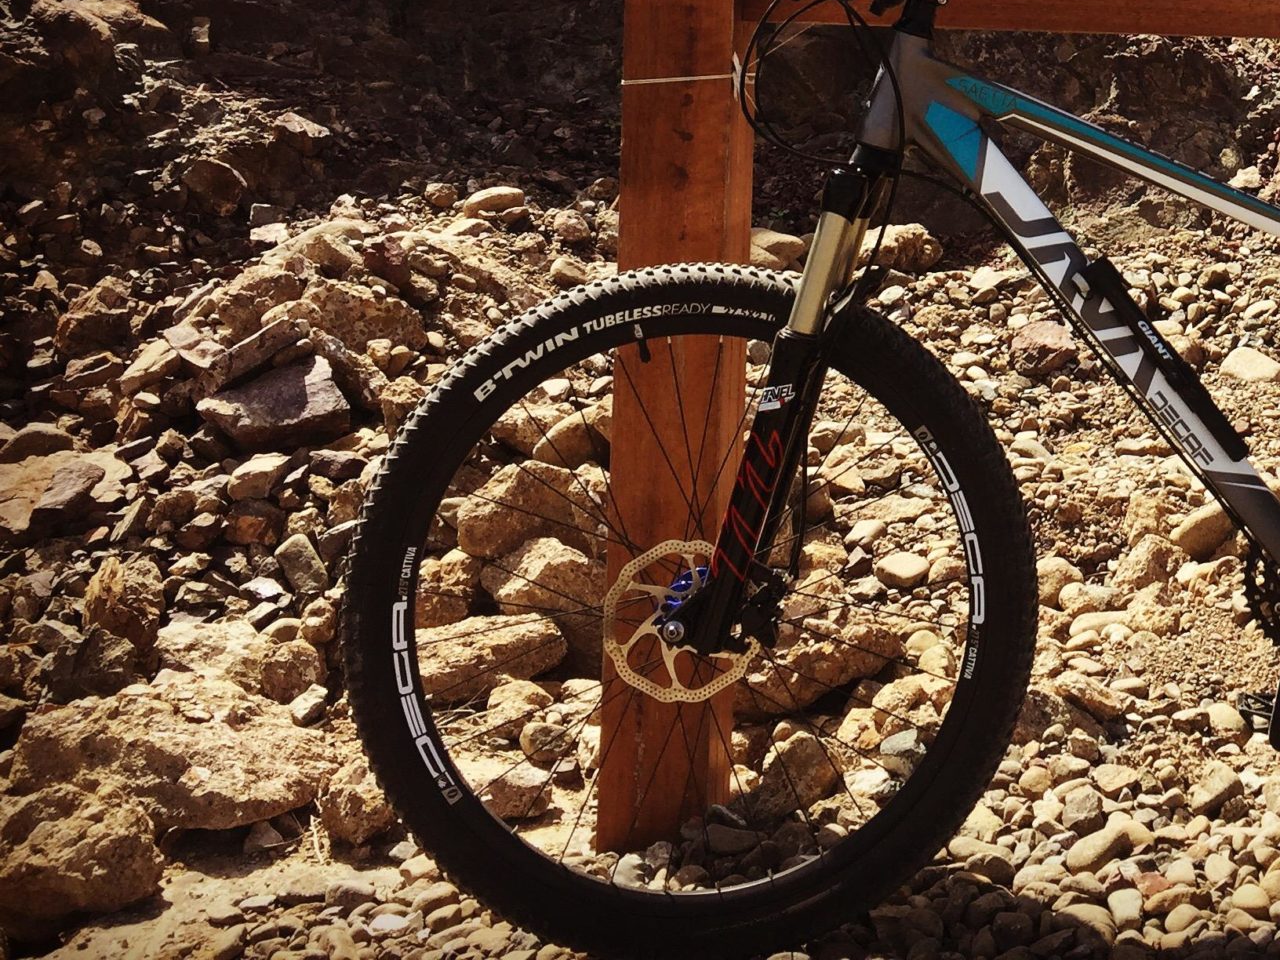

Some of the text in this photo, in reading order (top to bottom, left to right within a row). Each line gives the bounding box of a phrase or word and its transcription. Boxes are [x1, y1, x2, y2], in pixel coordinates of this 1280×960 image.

[1137, 320, 1174, 361] GIANT
[1148, 390, 1214, 467] DECAF
[401, 545, 418, 580] CATTIVA
[963, 647, 978, 680] CATTIVA
